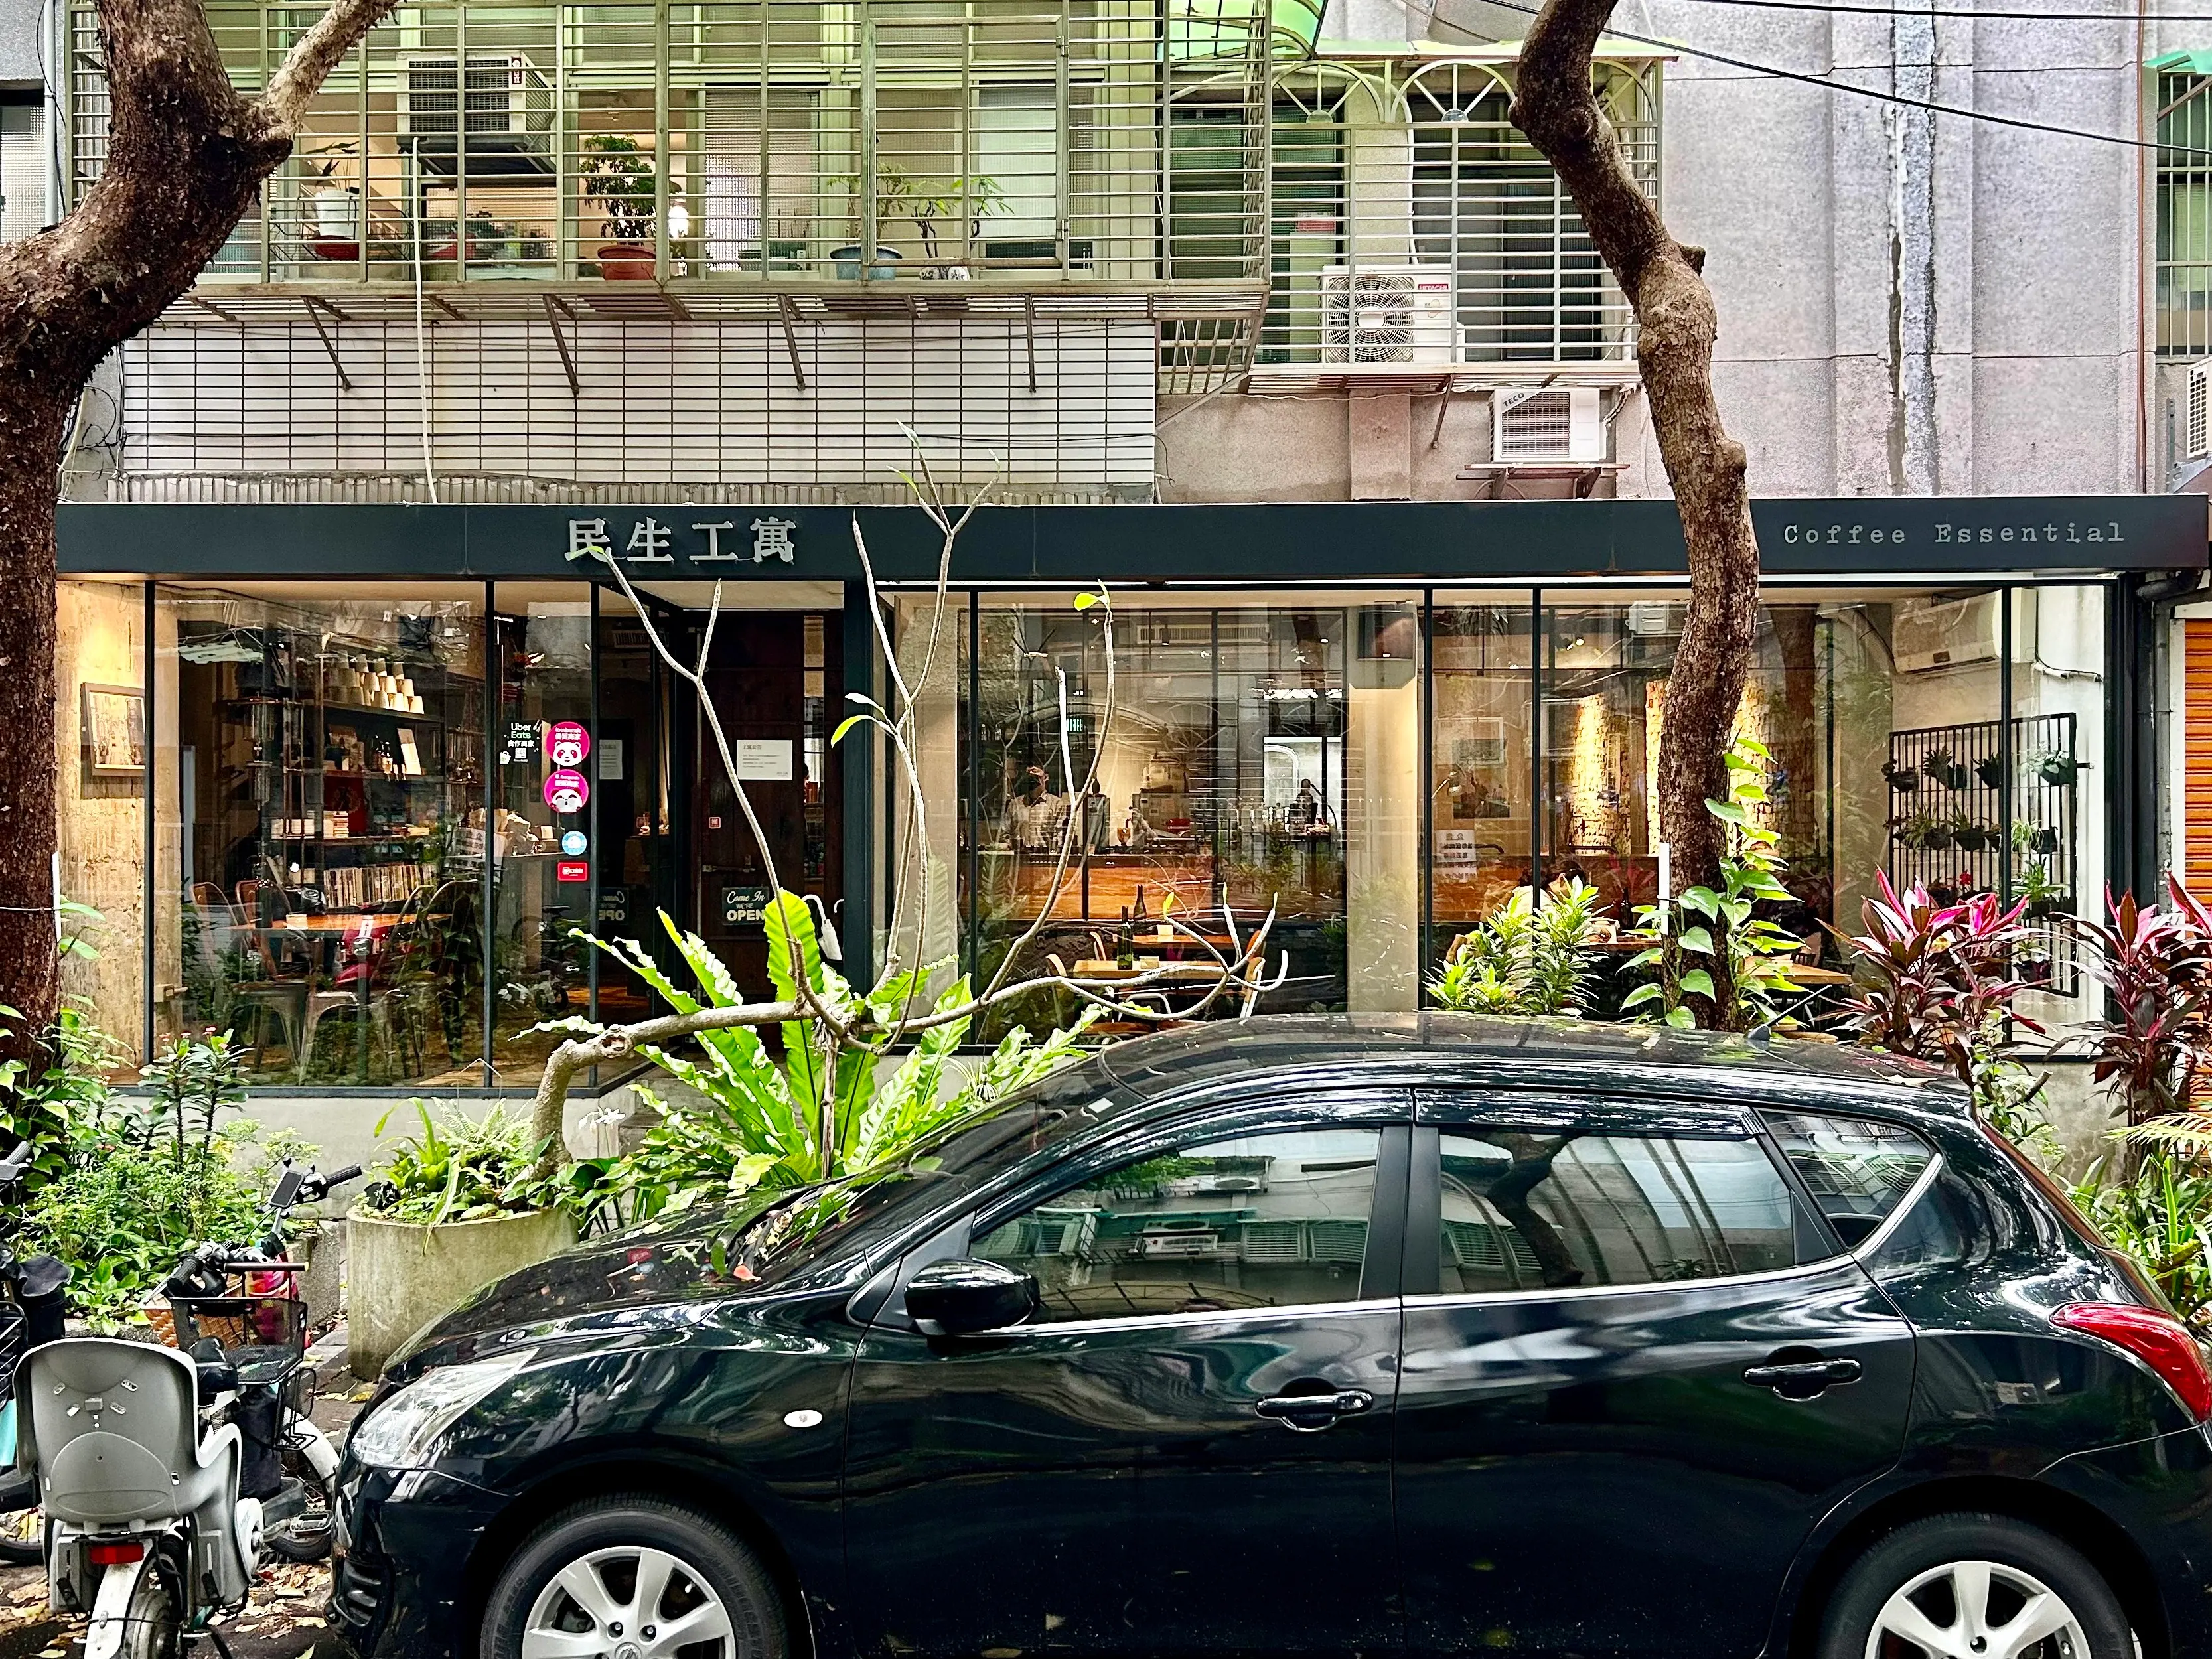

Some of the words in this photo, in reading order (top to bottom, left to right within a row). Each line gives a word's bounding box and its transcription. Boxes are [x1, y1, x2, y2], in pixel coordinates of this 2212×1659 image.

[1502, 392, 1525, 407] TECO
[564, 516, 796, 563] 民生工寓
[1783, 523, 1906, 545] Coffee
[1935, 522, 2124, 545] Essential
[727, 891, 750, 904] Come
[751, 890, 765, 902] In
[727, 910, 765, 921] OPEN
